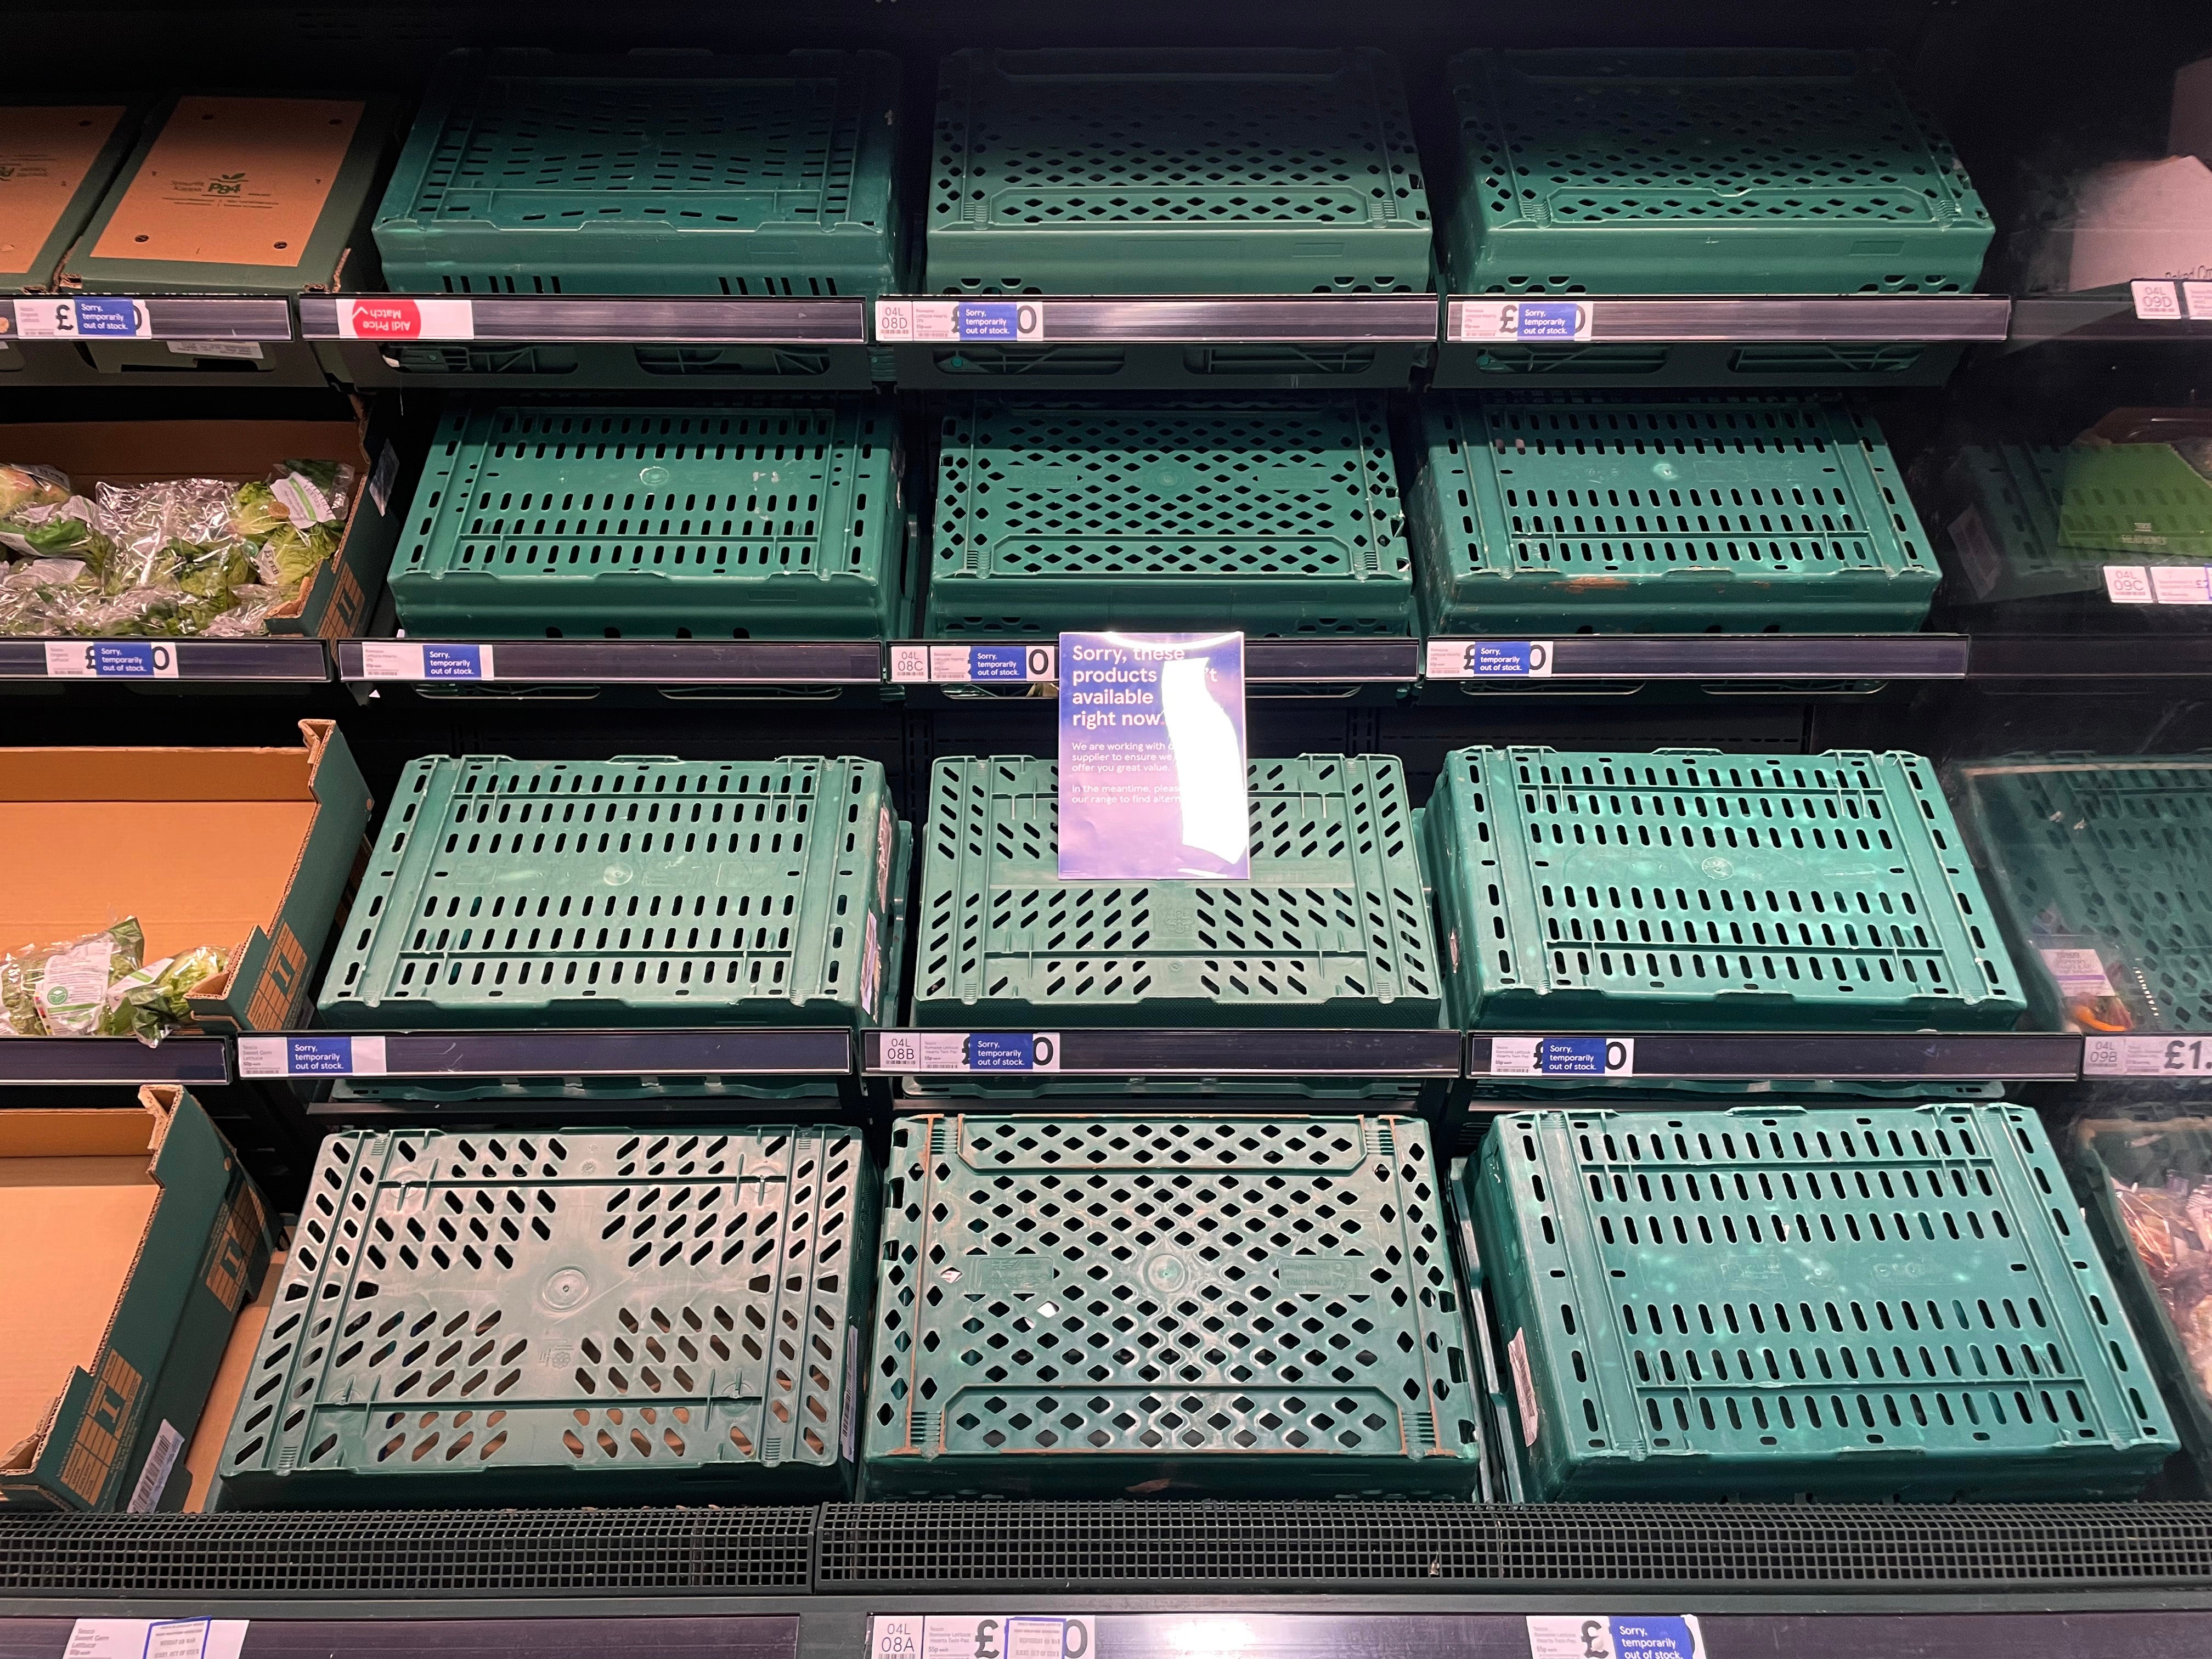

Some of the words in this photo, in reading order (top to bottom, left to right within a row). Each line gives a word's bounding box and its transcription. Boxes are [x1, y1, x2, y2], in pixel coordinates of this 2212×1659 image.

[81, 303, 103, 312] Sorry,
[885, 307, 904, 316] 04L
[56, 304, 74, 330] £
[82, 313, 125, 323] temporarily
[370, 309, 401, 319] Match
[966, 309, 986, 317] Sorry,
[1525, 309, 1545, 318] Sorry,
[882, 318, 907, 329] 08D
[966, 318, 1006, 326] temporarily
[1017, 305, 1036, 334] 0
[1499, 304, 1518, 333] £
[1525, 318, 1565, 326] temporarily
[363, 321, 389, 330] Price
[392, 321, 410, 330] Aldi
[2115, 571, 2136, 579] 04L
[2114, 580, 2143, 590] 09C
[152, 646, 170, 670] 0
[1073, 645, 1127, 664] Sorry,
[1133, 647, 1185, 661] these
[1530, 645, 1546, 670] 0
[898, 661, 923, 671] 08C
[1029, 649, 1049, 675] 0
[1073, 668, 1156, 686] products
[1073, 689, 1153, 704] available
[1073, 711, 1115, 730] right
[1107, 743, 1143, 752] working
[1072, 753, 1109, 763] supplier
[1116, 764, 1141, 773] great
[1154, 785, 1181, 795] pleas
[1091, 796, 1117, 805] range
[891, 1039, 911, 1047] 04L
[978, 1041, 1000, 1049] Sorry,
[2096, 1041, 2114, 1049] 04L
[888, 1048, 914, 1059] 08B
[1032, 1037, 1053, 1065] 0
[1550, 1045, 1572, 1053] Sorry,
[295, 1053, 340, 1062] temporarily
[1605, 1042, 1627, 1070] 0
[888, 1624, 911, 1634] 04L
[1620, 1626, 1647, 1637] Sorry,
[974, 1620, 1000, 1659] £
[1065, 1619, 1088, 1658] 0
[1622, 1638, 1675, 1649] temporarily
[882, 1637, 914, 1652] 08A
[1624, 1651, 1641, 1659] out
[1643, 1650, 1652, 1659] of
[1655, 1651, 1683, 1659] stock.
